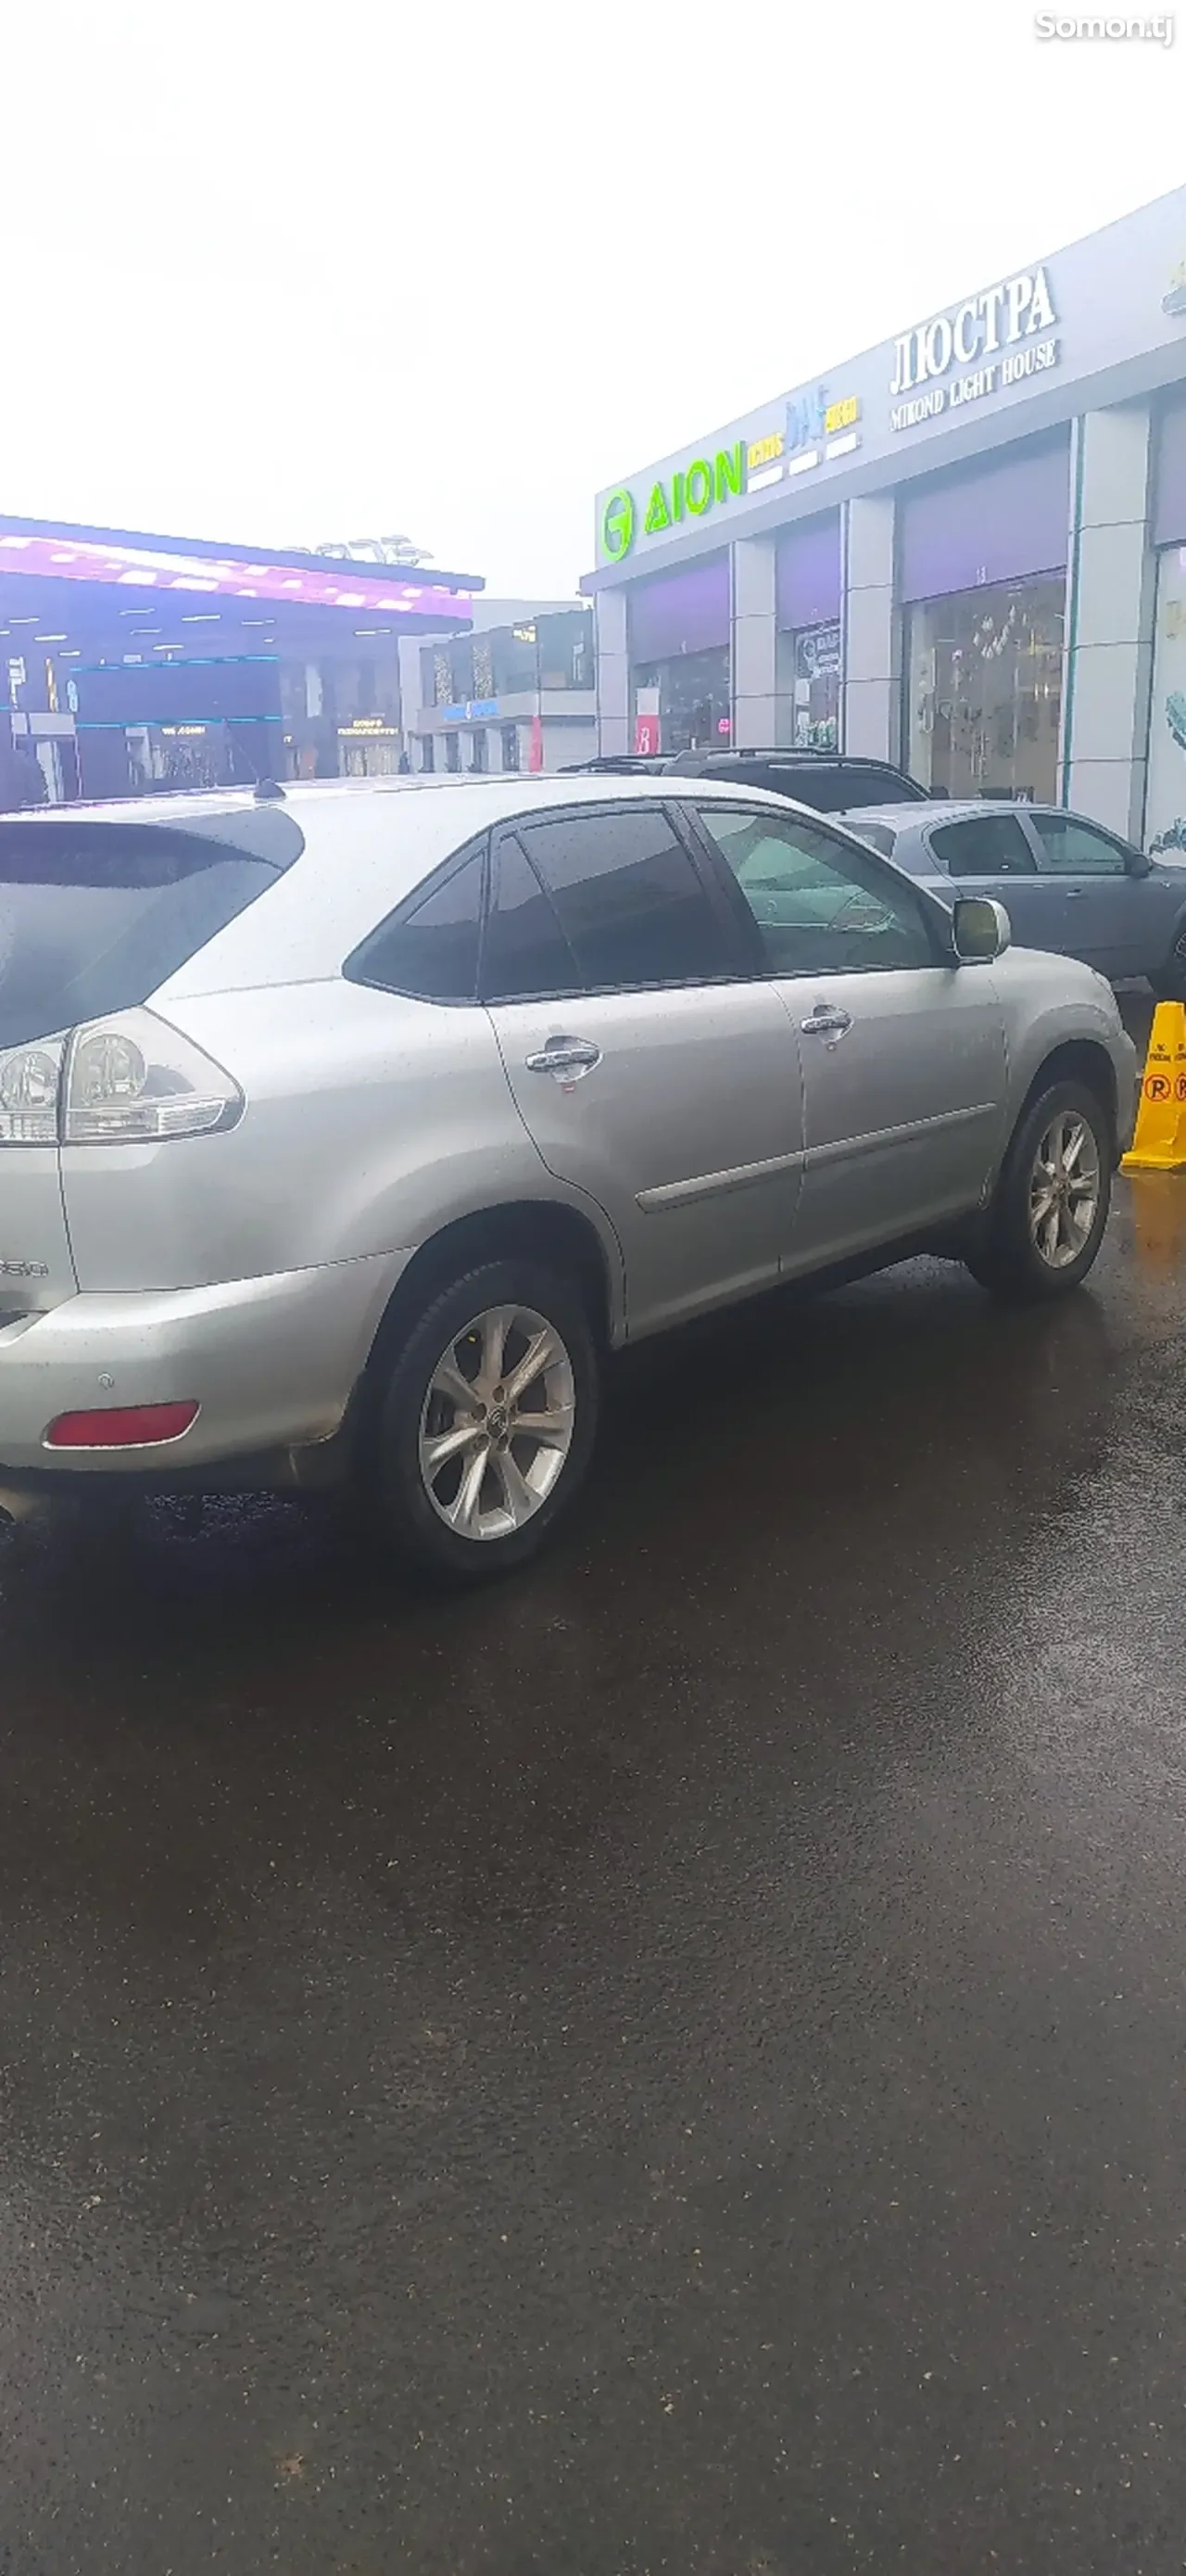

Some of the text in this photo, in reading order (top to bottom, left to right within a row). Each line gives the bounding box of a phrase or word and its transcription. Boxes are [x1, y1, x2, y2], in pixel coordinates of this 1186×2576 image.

[890, 266, 1056, 396] ЛЮСТРА
[949, 365, 998, 408] LIGHT
[1002, 338, 1057, 387] HOUSE
[643, 439, 745, 536] AION
